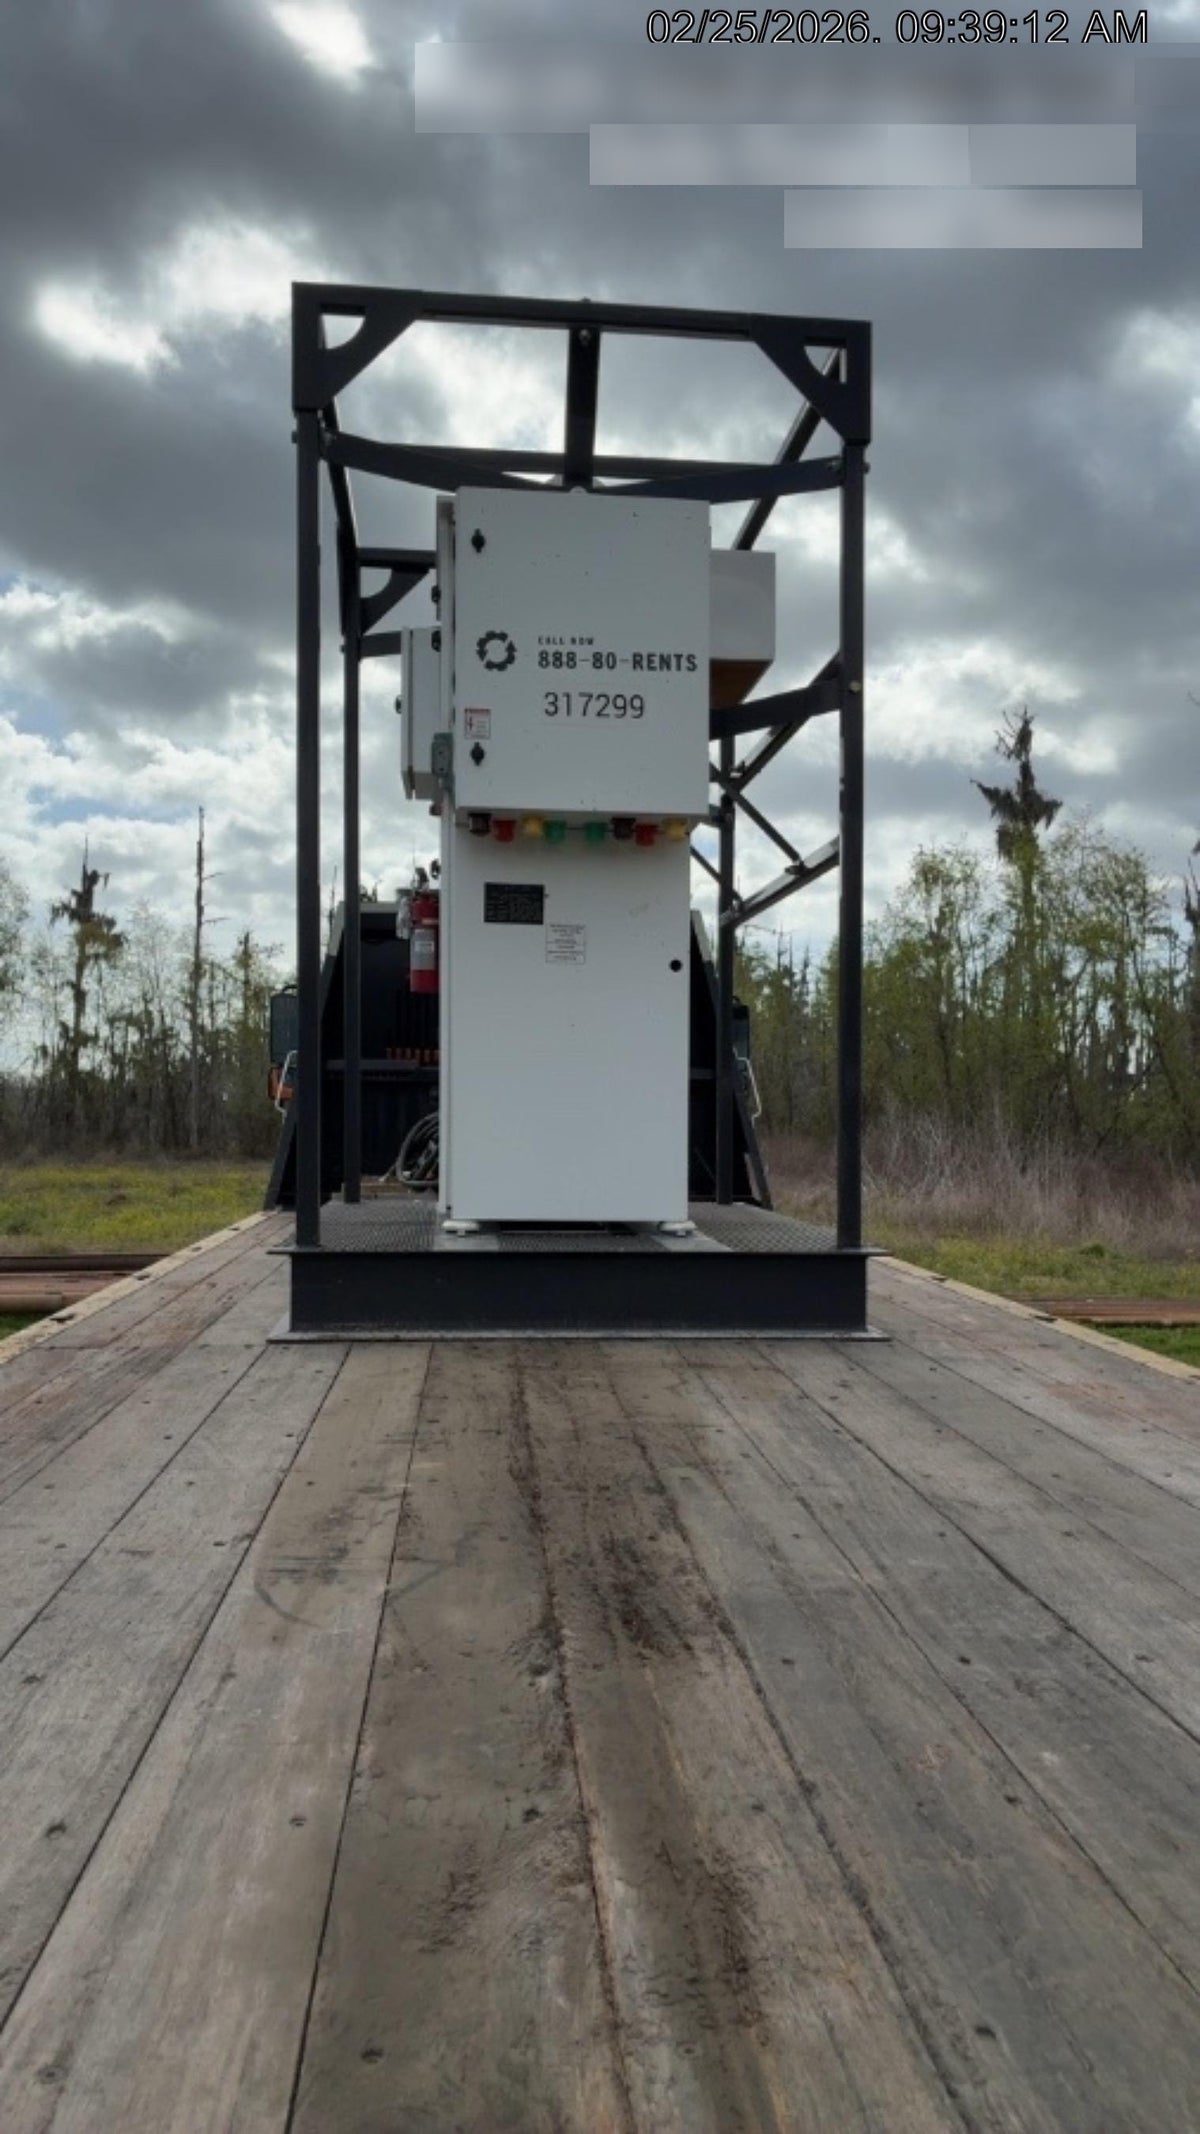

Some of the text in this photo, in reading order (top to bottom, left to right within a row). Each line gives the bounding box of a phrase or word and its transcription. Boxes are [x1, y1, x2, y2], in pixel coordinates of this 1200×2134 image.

[537, 636, 595, 646] CALL NOW
[537, 650, 698, 672] 888-80-RENTS
[543, 691, 645, 719] 317299
